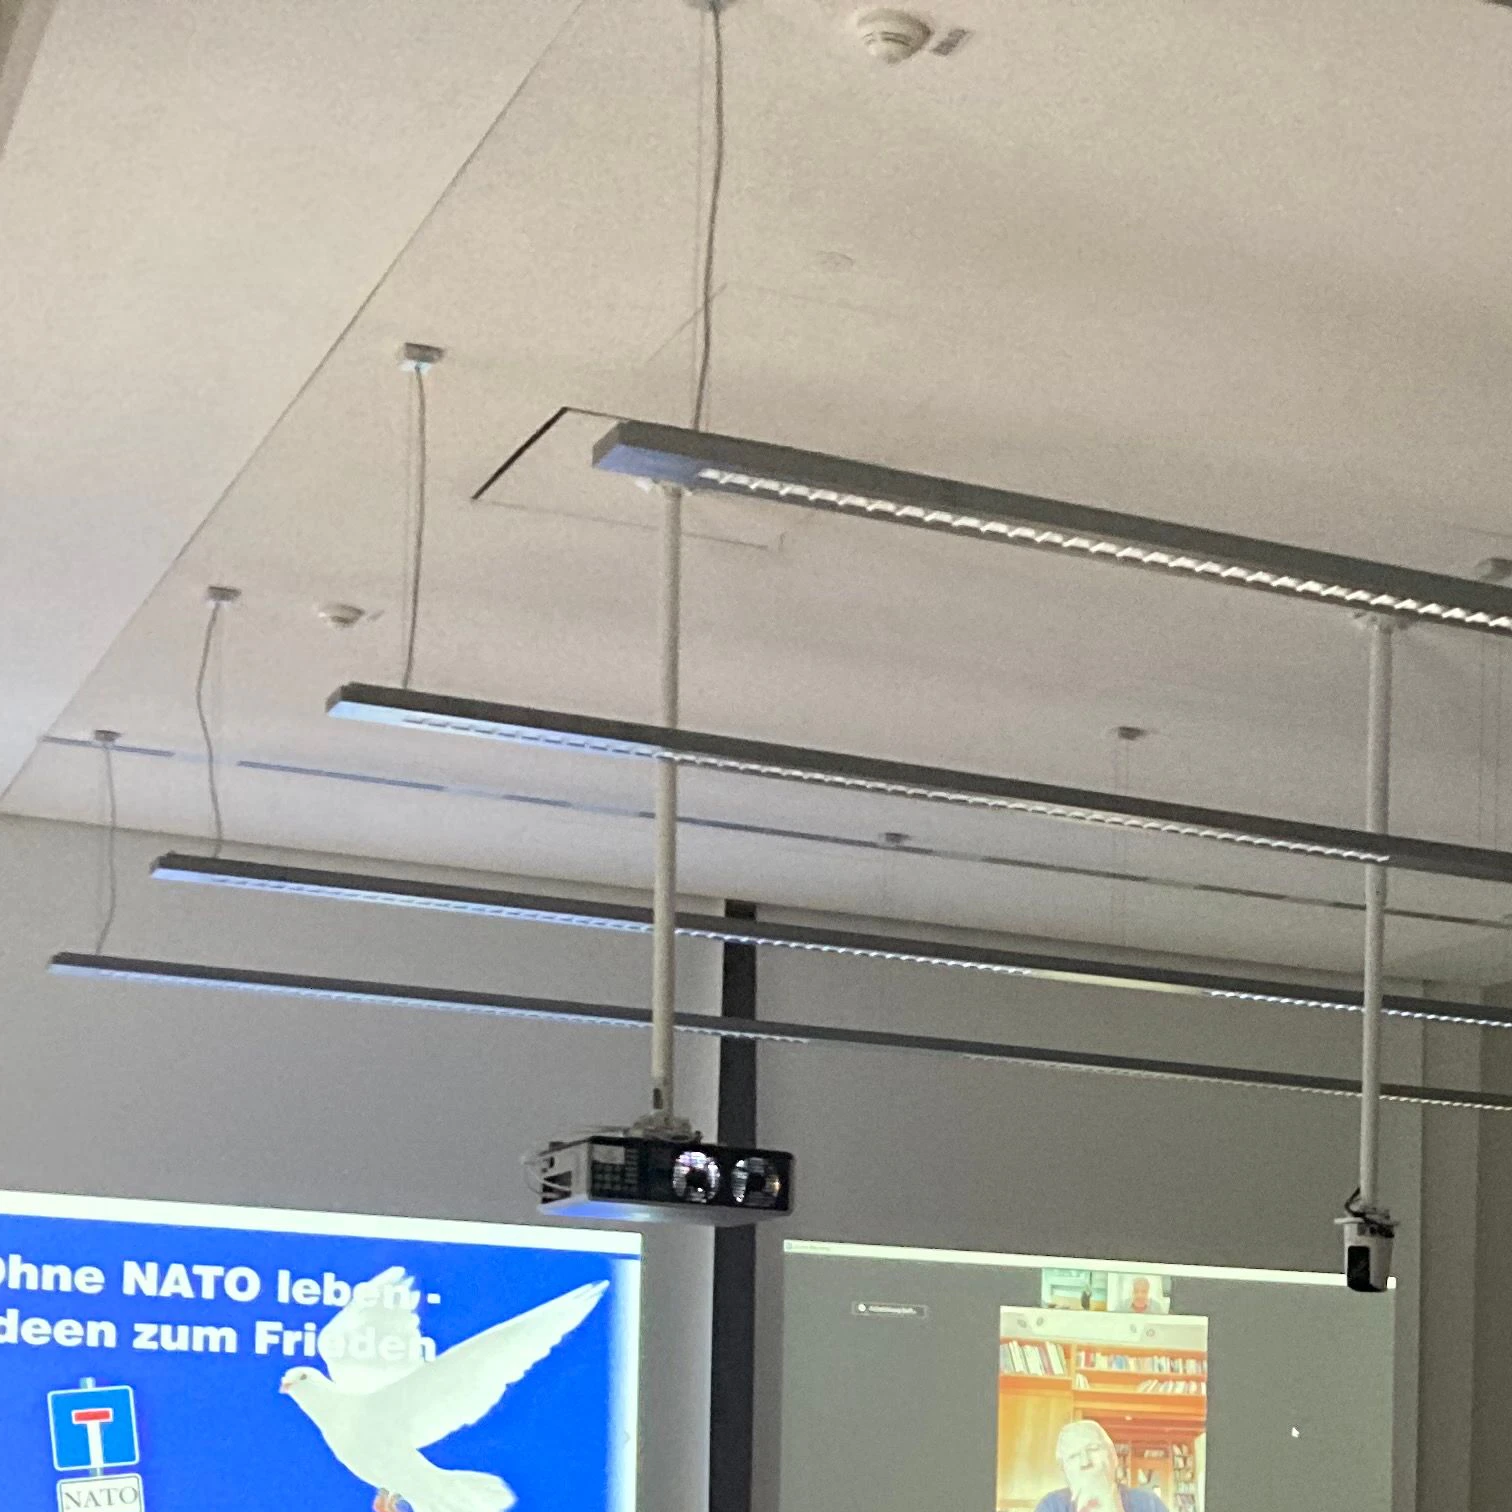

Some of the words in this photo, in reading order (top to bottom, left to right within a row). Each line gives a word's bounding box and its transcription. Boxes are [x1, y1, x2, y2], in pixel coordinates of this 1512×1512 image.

[0, 1254, 105, 1294] hne
[122, 1260, 261, 1302] NATO
[132, 1323, 238, 1353] zum
[64, 1486, 139, 1510] NATO
